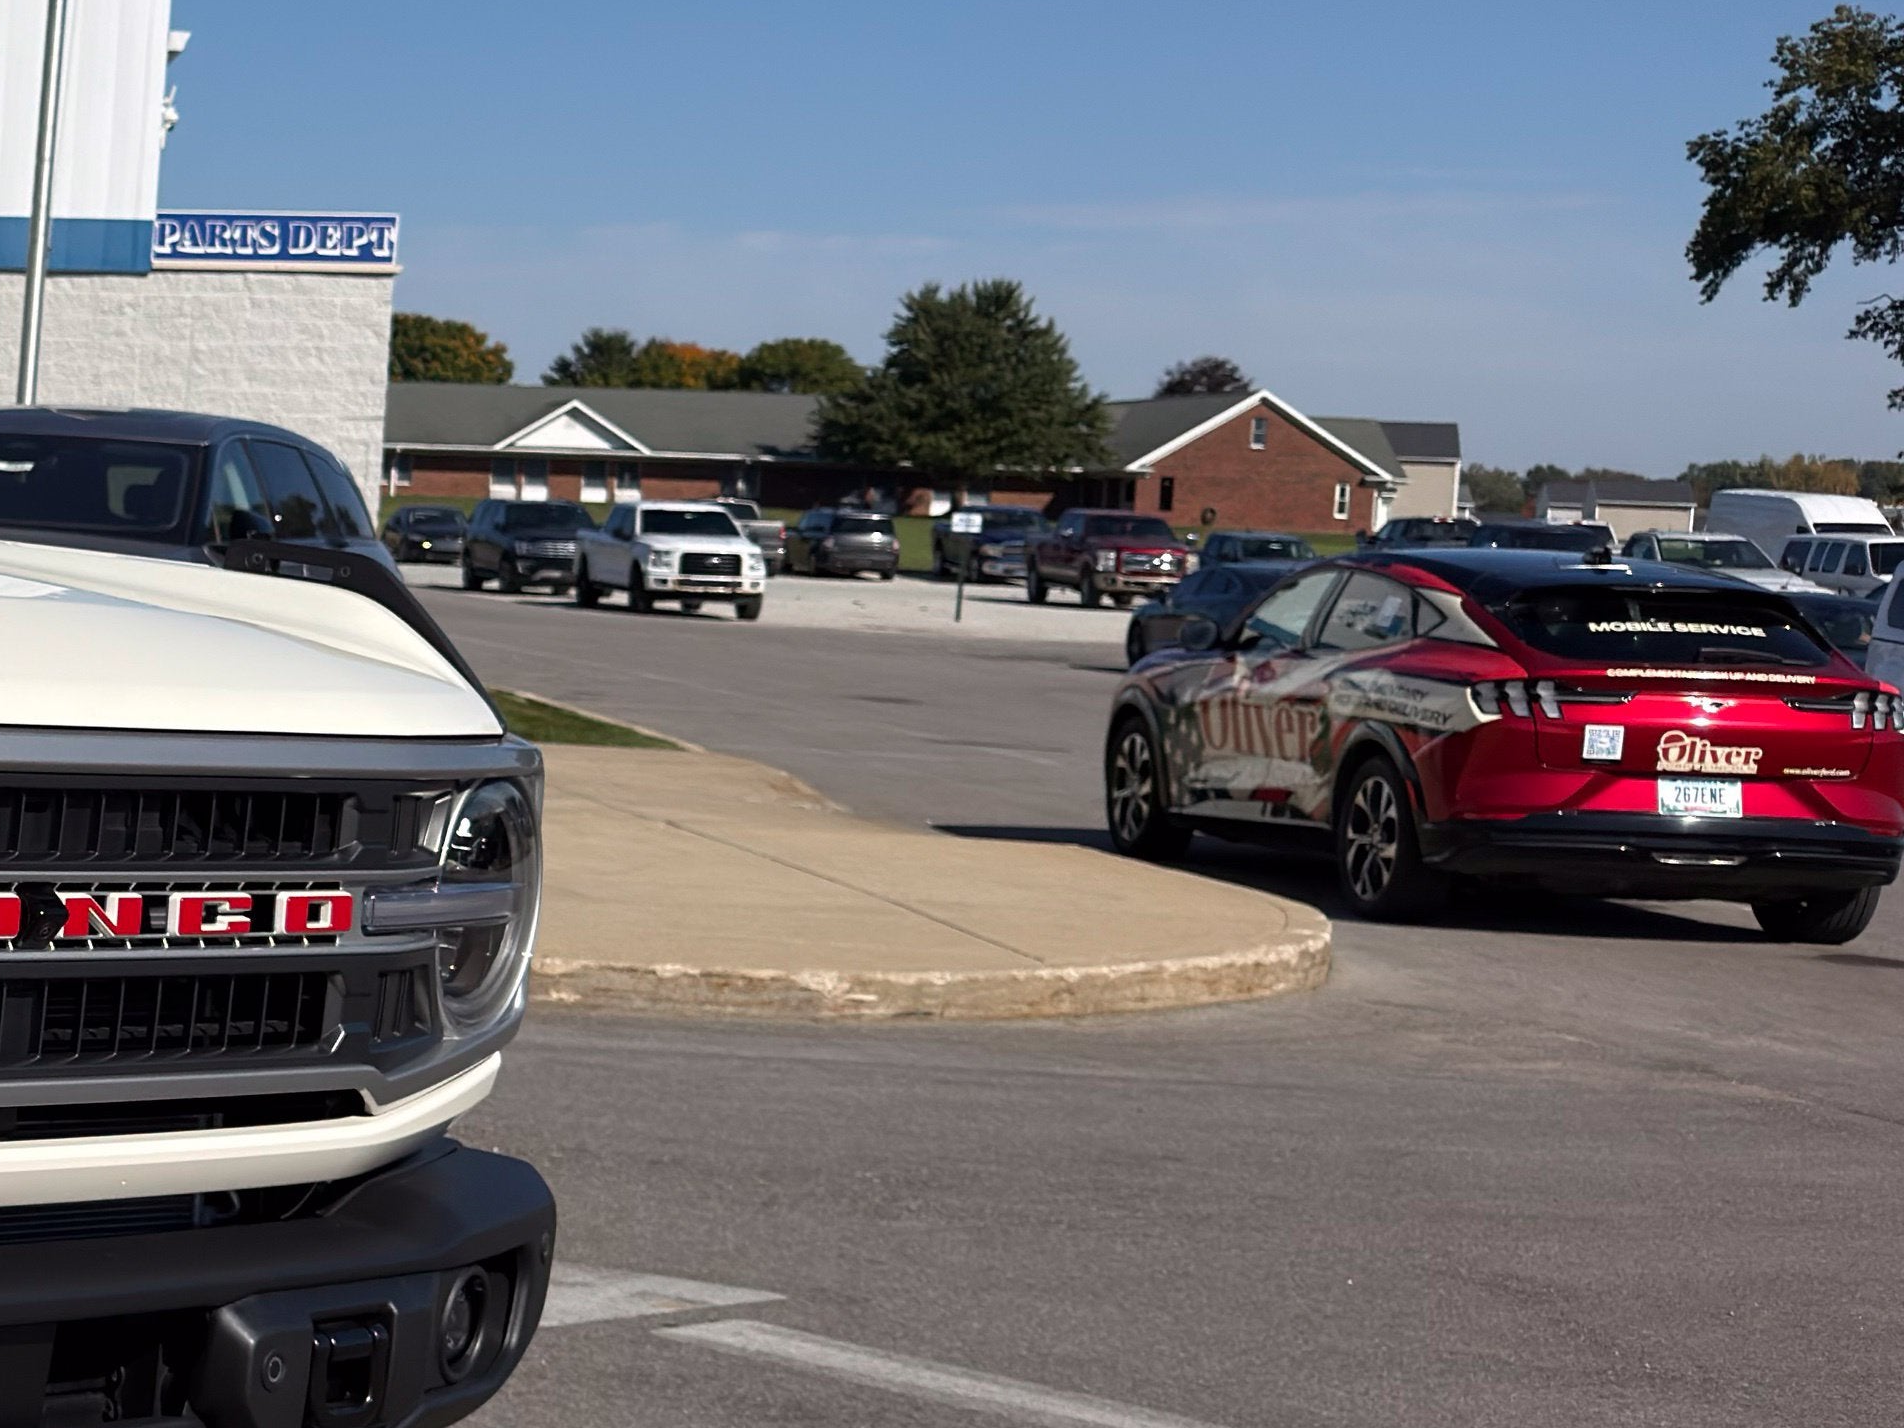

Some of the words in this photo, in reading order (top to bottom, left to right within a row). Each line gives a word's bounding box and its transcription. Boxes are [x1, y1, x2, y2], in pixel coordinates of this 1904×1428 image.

[153, 219, 281, 256] PARTS
[286, 221, 396, 258] DEPT
[1588, 622, 1673, 634] MOBILE
[1673, 622, 1767, 638] SERVICE
[1656, 729, 1763, 767] Oliver
[1674, 785, 1727, 806] 267ENE
